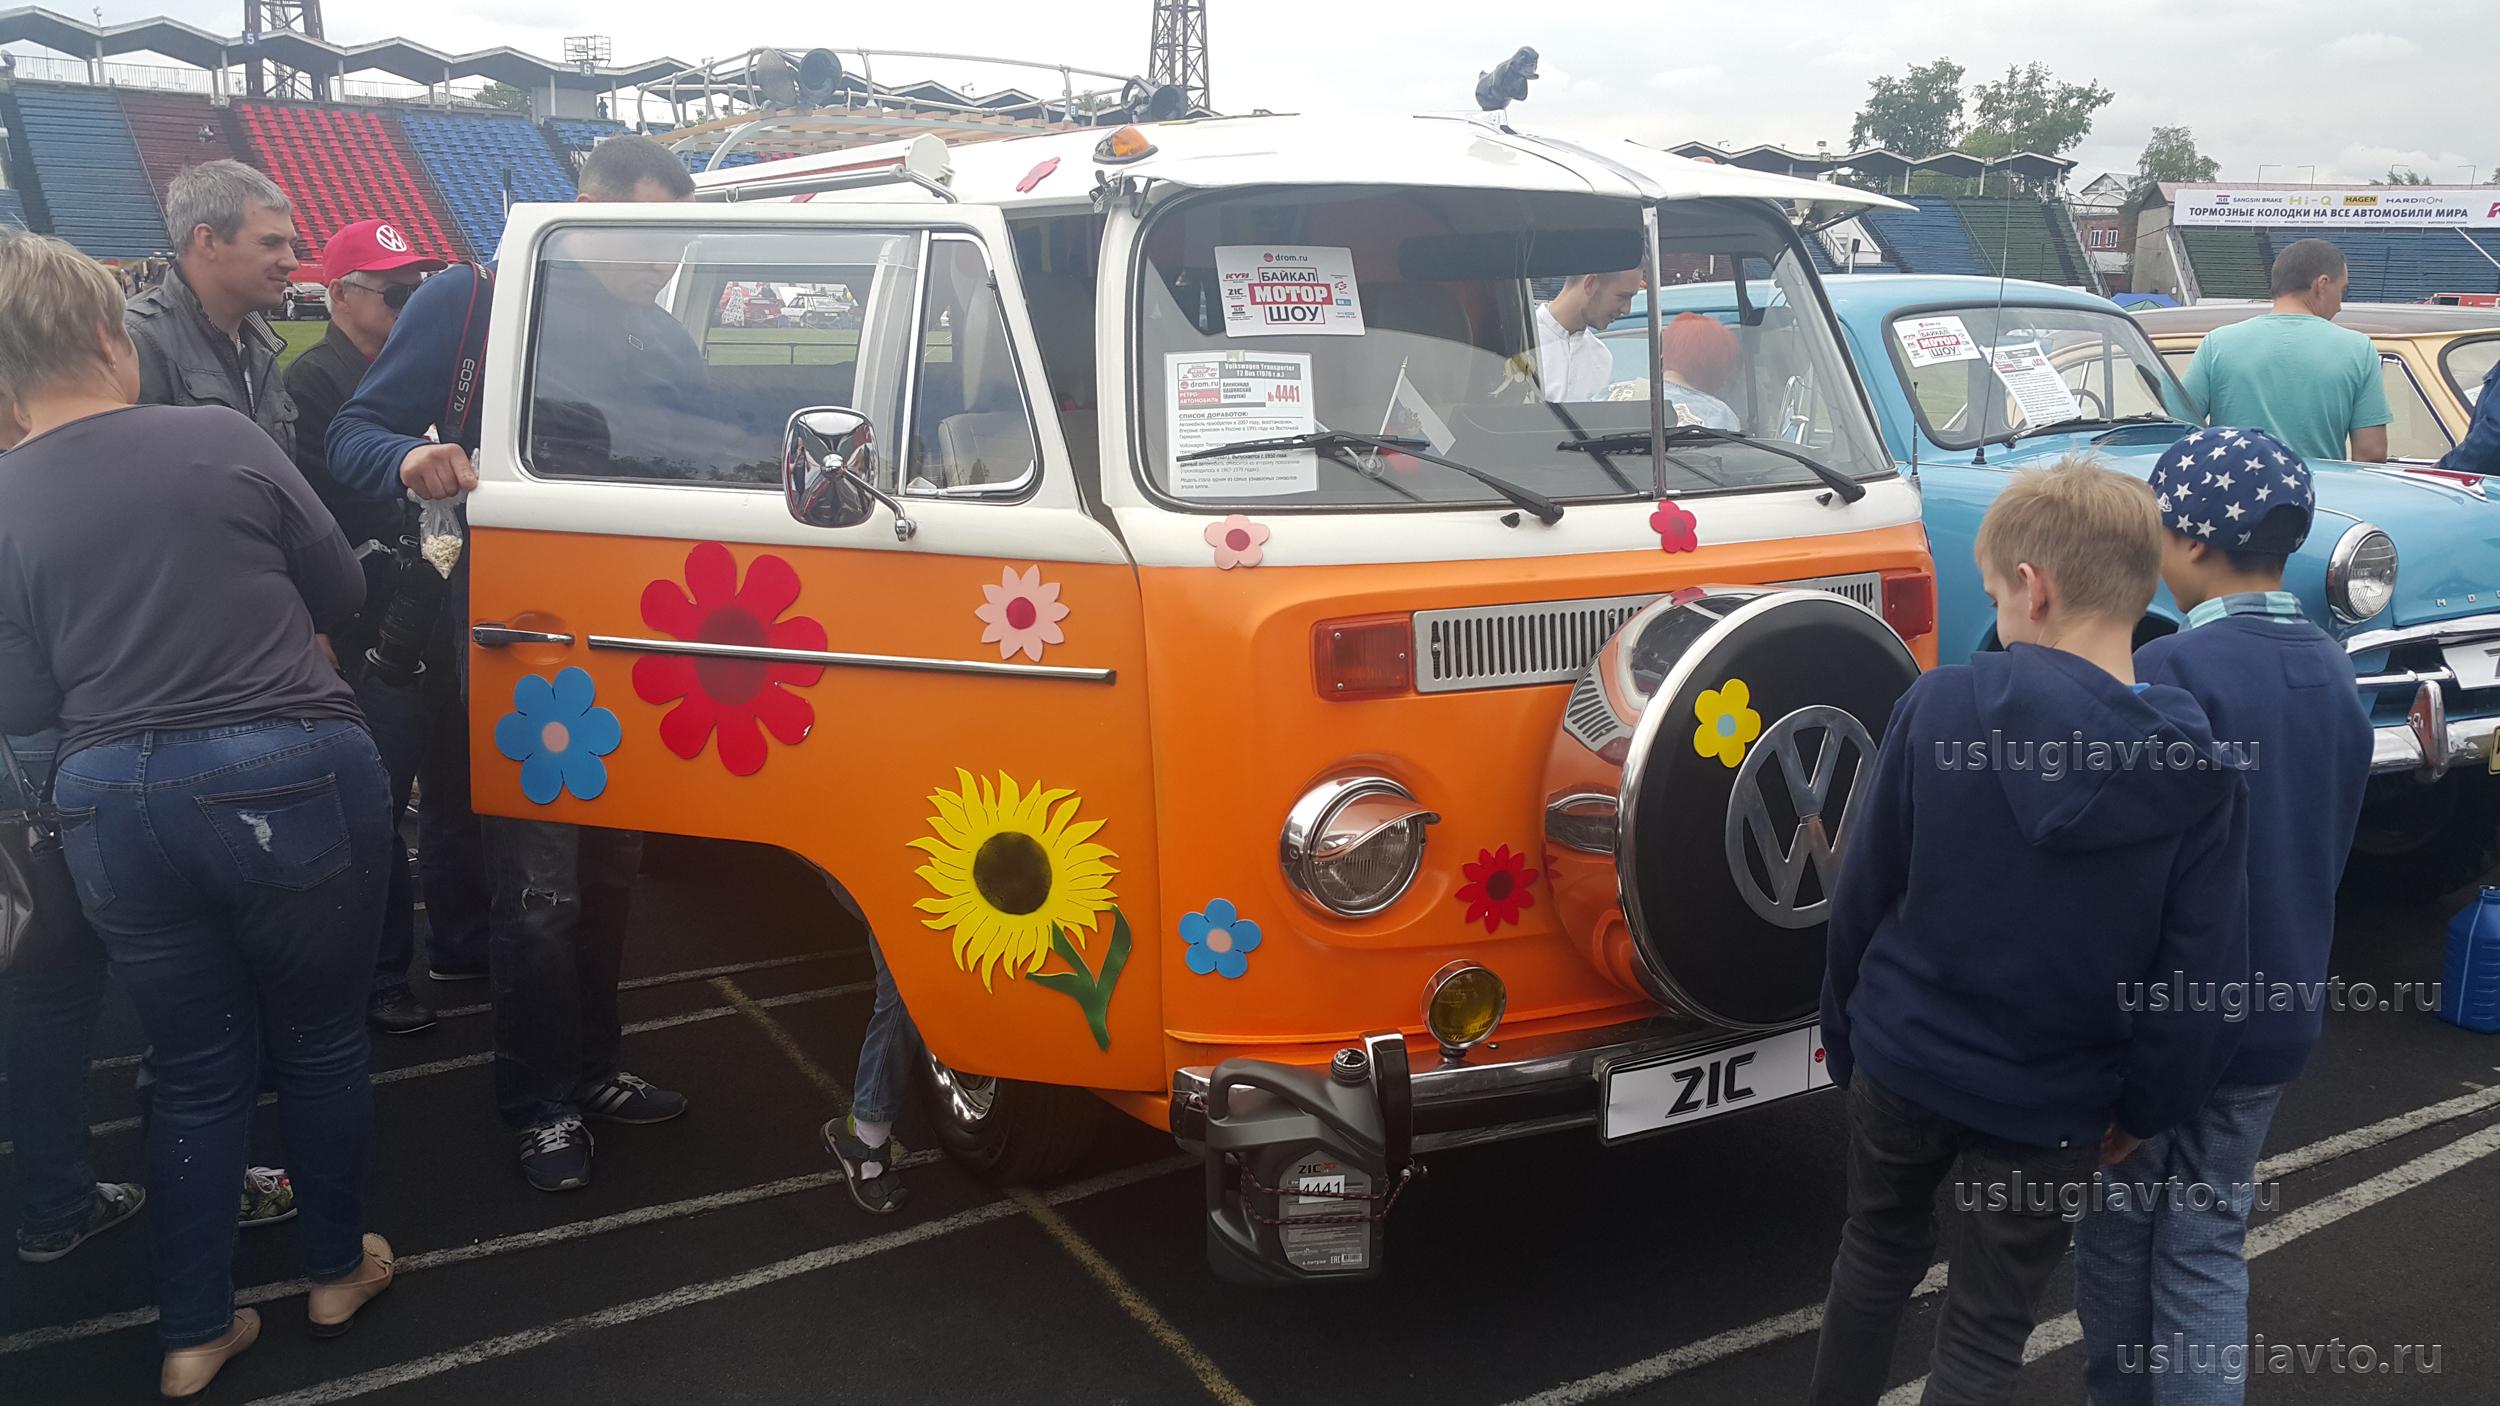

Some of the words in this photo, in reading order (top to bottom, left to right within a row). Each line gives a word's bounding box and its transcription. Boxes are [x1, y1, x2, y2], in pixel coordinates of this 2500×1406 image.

[247, 32, 255, 45] 5
[584, 63, 591, 75] 6
[2289, 195, 2332, 206] Hi-Q
[2386, 196, 2443, 204] HARDRON
[2189, 207, 2255, 217] ТОРМОЗНЫЕ
[2257, 208, 2311, 218] КОЛОДКИ
[2313, 208, 2328, 217] НА
[2330, 208, 2350, 217] ВСЕ
[2352, 208, 2432, 218] АВТОМОБИЛИ
[2435, 208, 2468, 218] МИРА
[1275, 252, 1308, 262] drom.ru
[1261, 270, 1316, 282] БАЙКАЛ
[1254, 285, 1328, 303] МОТОР
[1269, 306, 1319, 322] ШОУ
[1920, 335, 1958, 348] МОТОР
[1931, 346, 1956, 357] ШОУ
[458, 358, 475, 393] EOS
[1275, 384, 1300, 402] 4441
[453, 397, 466, 412] 7D
[1207, 411, 1249, 419] ДОРАБОТОК:
[1665, 1051, 1758, 1118] ZIC
[1298, 1163, 1321, 1174] ZIC
[1302, 1181, 1342, 1195] 4441
